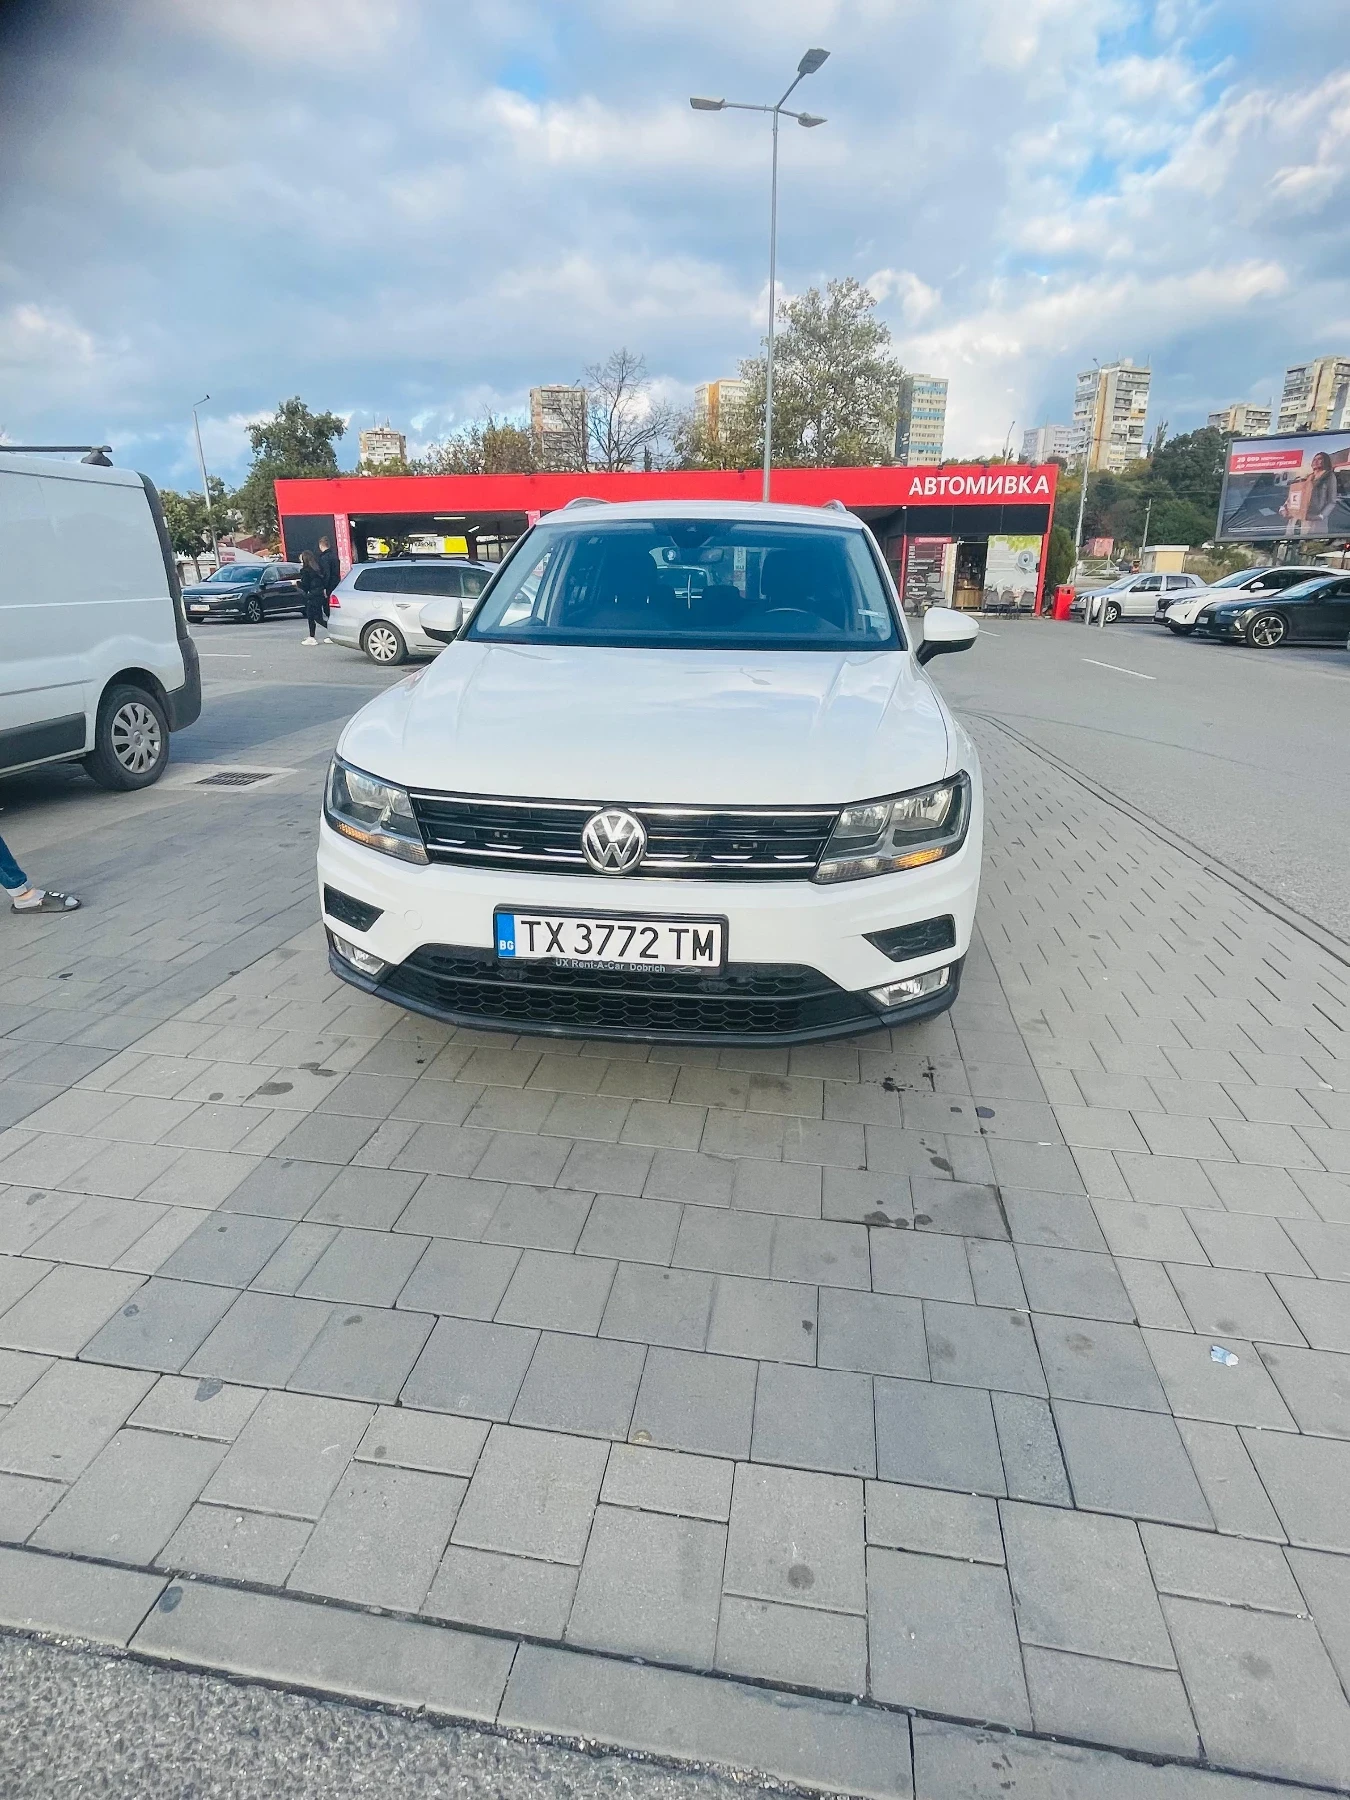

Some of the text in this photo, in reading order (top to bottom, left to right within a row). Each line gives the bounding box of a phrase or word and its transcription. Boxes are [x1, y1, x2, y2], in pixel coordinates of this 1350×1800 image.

[908, 475, 1050, 496] АВТОМИВКА
[499, 940, 514, 951] BG
[574, 923, 660, 959] 3772
[669, 928, 714, 961] TM
[571, 959, 625, 971] Rent-A-Car
[629, 963, 666, 973] Dobrich
